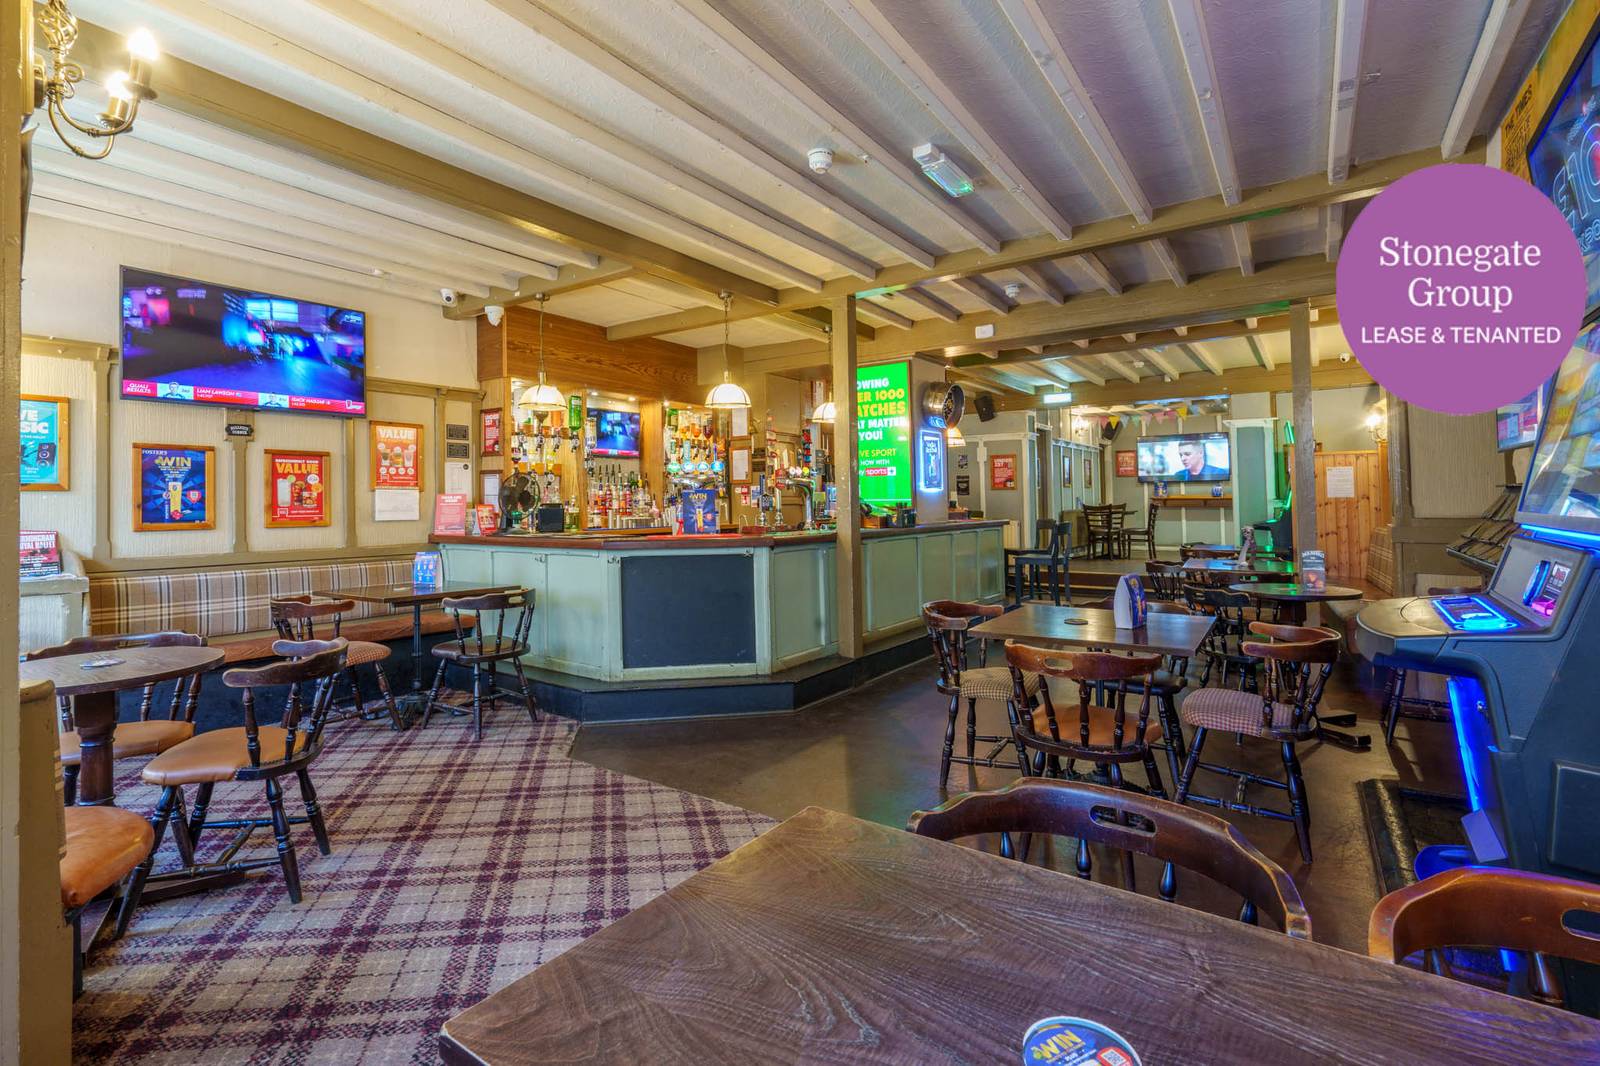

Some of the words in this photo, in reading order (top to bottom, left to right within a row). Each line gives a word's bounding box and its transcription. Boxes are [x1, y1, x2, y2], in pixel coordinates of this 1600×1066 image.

[875, 388, 905, 400] 1000
[379, 428, 415, 440] VALUE
[859, 430, 883, 441] YOU!
[871, 447, 896, 457] SPORT
[158, 456, 192, 468] WIN
[276, 462, 320, 474] VALUE
[1032, 1029, 1082, 1060] WIN
